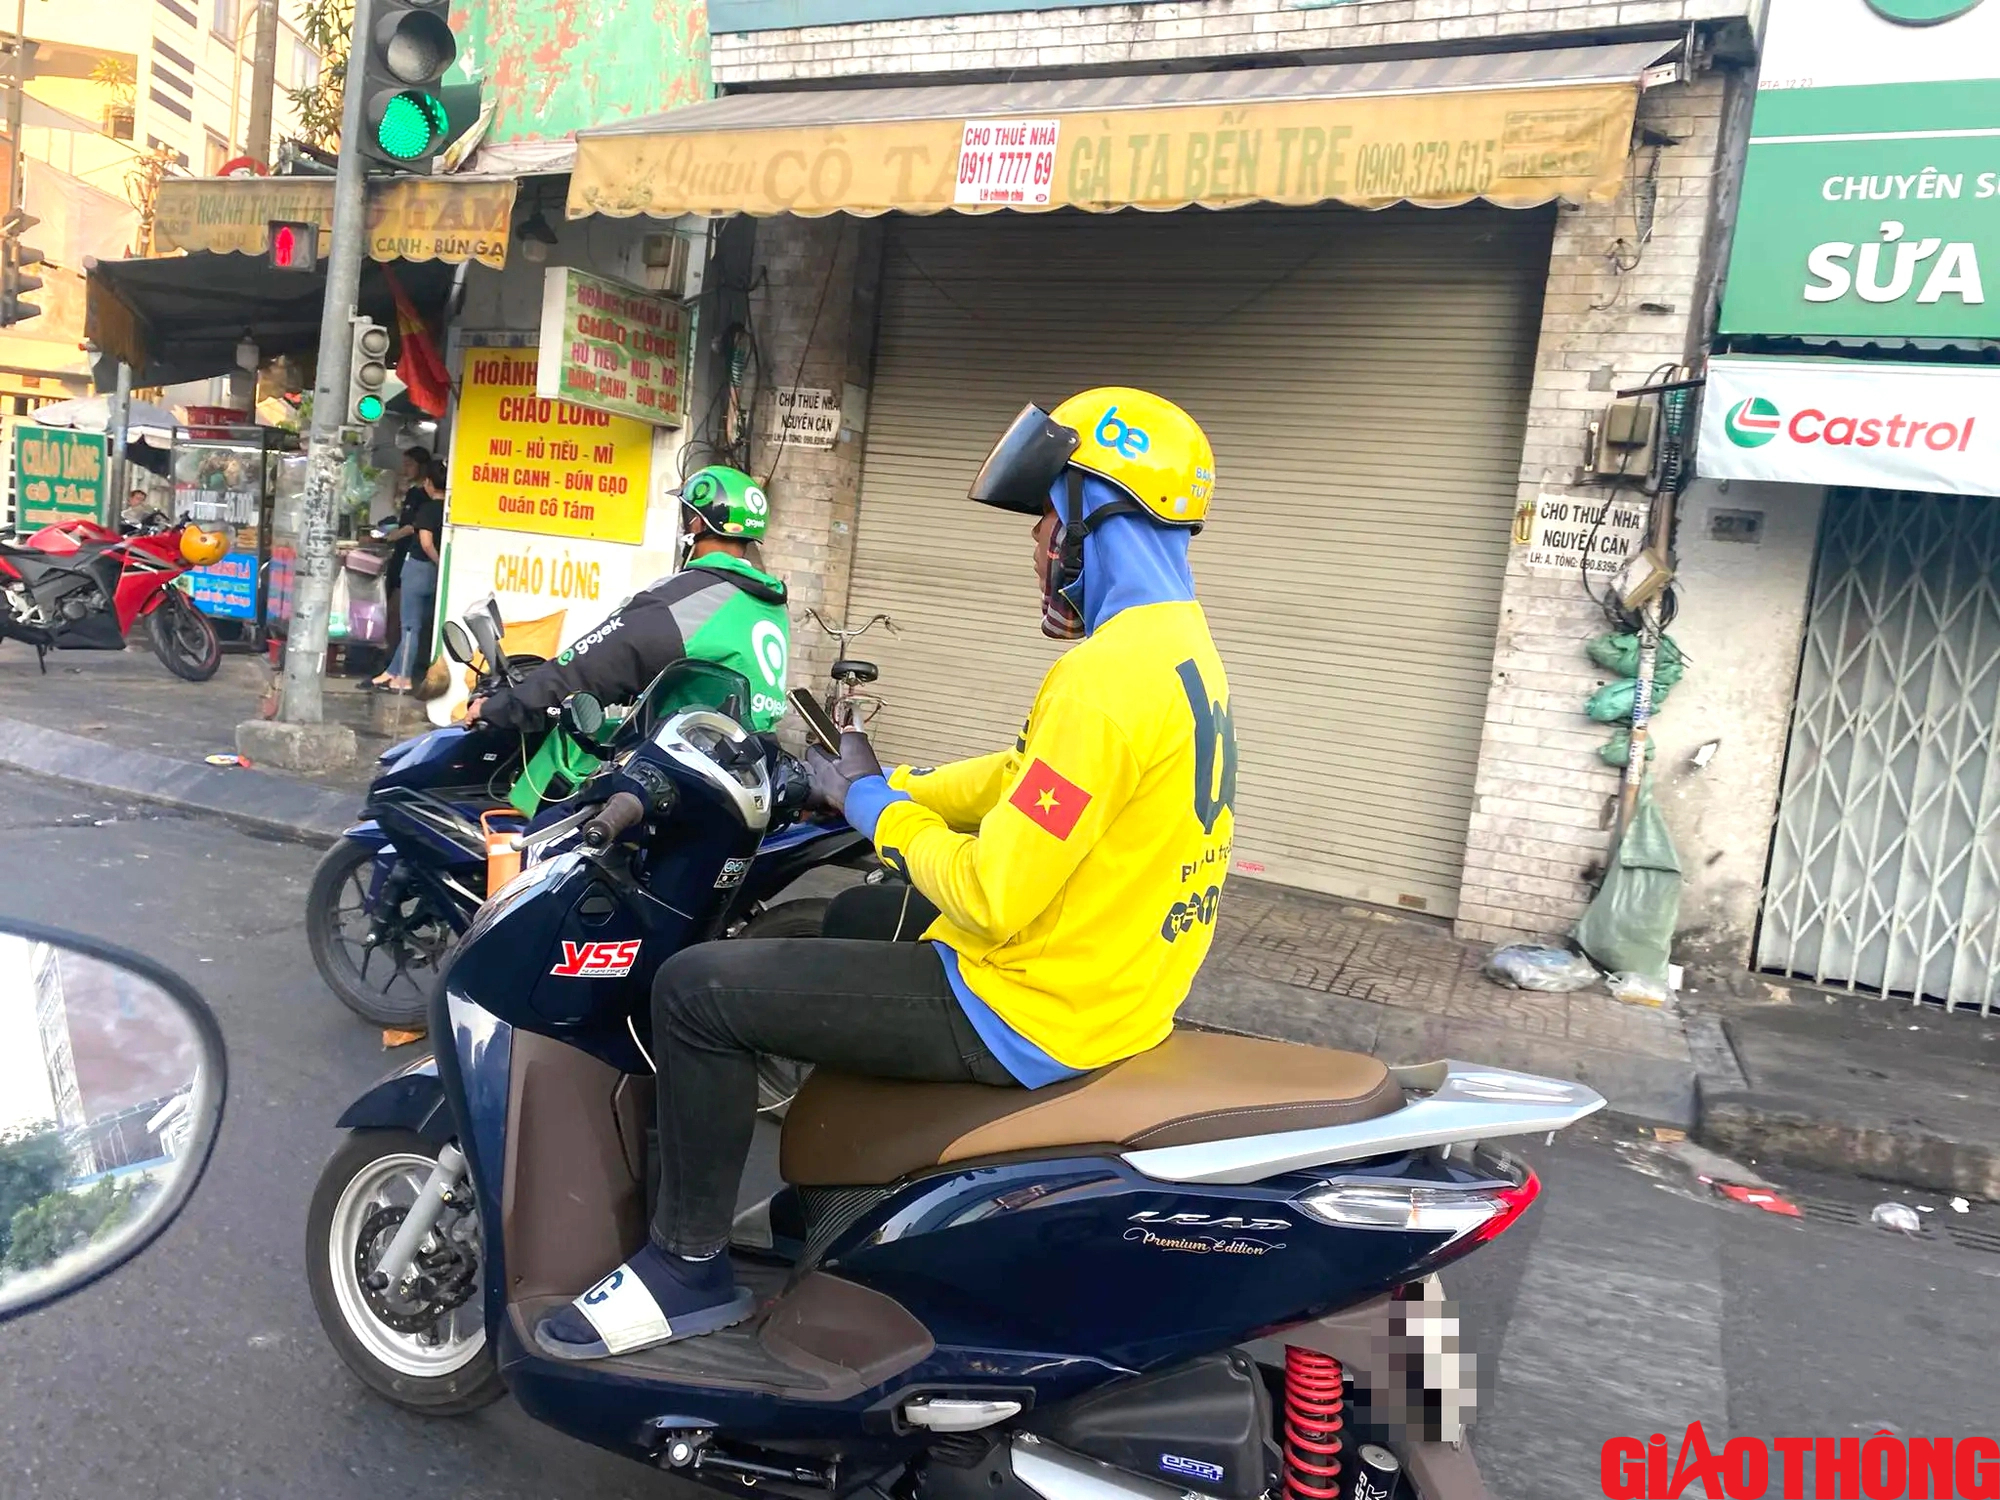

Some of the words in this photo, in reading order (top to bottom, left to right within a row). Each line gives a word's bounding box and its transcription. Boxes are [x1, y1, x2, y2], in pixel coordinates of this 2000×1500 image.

[965, 127, 991, 146] CHO
[995, 122, 1027, 146] THUÊ
[1029, 121, 1056, 146] NHÀ
[762, 129, 853, 208] CÔ
[960, 151, 993, 184] 0911
[997, 152, 1032, 184] 7777
[1034, 151, 1053, 185] 69
[1068, 119, 1112, 201] GÀ
[1128, 133, 1170, 201] TA
[1184, 111, 1262, 199] BẾN
[1276, 125, 1353, 196] TRE
[1355, 139, 1497, 197] 0909.373.615
[1822, 166, 1963, 201] CHUYÊN
[1975, 172, 2000, 198] S
[375, 237, 422, 254] CANH
[435, 234, 471, 255] BÚN
[1803, 220, 1985, 304] SỬA
[1095, 406, 1150, 460] be
[1788, 408, 1975, 452] Castrol
[490, 439, 512, 457] NUI
[526, 436, 545, 459] HỦ
[550, 439, 578, 461] TIẾU
[593, 443, 615, 464] MÌ
[472, 462, 509, 484] BÁNH
[513, 468, 550, 488] CANH
[565, 470, 593, 492] BÚN
[598, 475, 628, 497] GẠO
[498, 495, 535, 515] Quán
[540, 498, 558, 517] Cô
[563, 500, 595, 521] Tám
[1541, 502, 1568, 521] CHO
[1572, 503, 1607, 526] THUÊ
[1542, 529, 1597, 552] NGUYÊN
[1600, 534, 1630, 556] CĂN
[494, 546, 543, 595] CHÁO
[549, 550, 600, 601] LÒNG
[574, 616, 625, 655] gojek
[1127, 1211, 1292, 1230] LEAD
[1139, 1231, 1210, 1252] Premium
[1212, 1238, 1264, 1255] Edition
